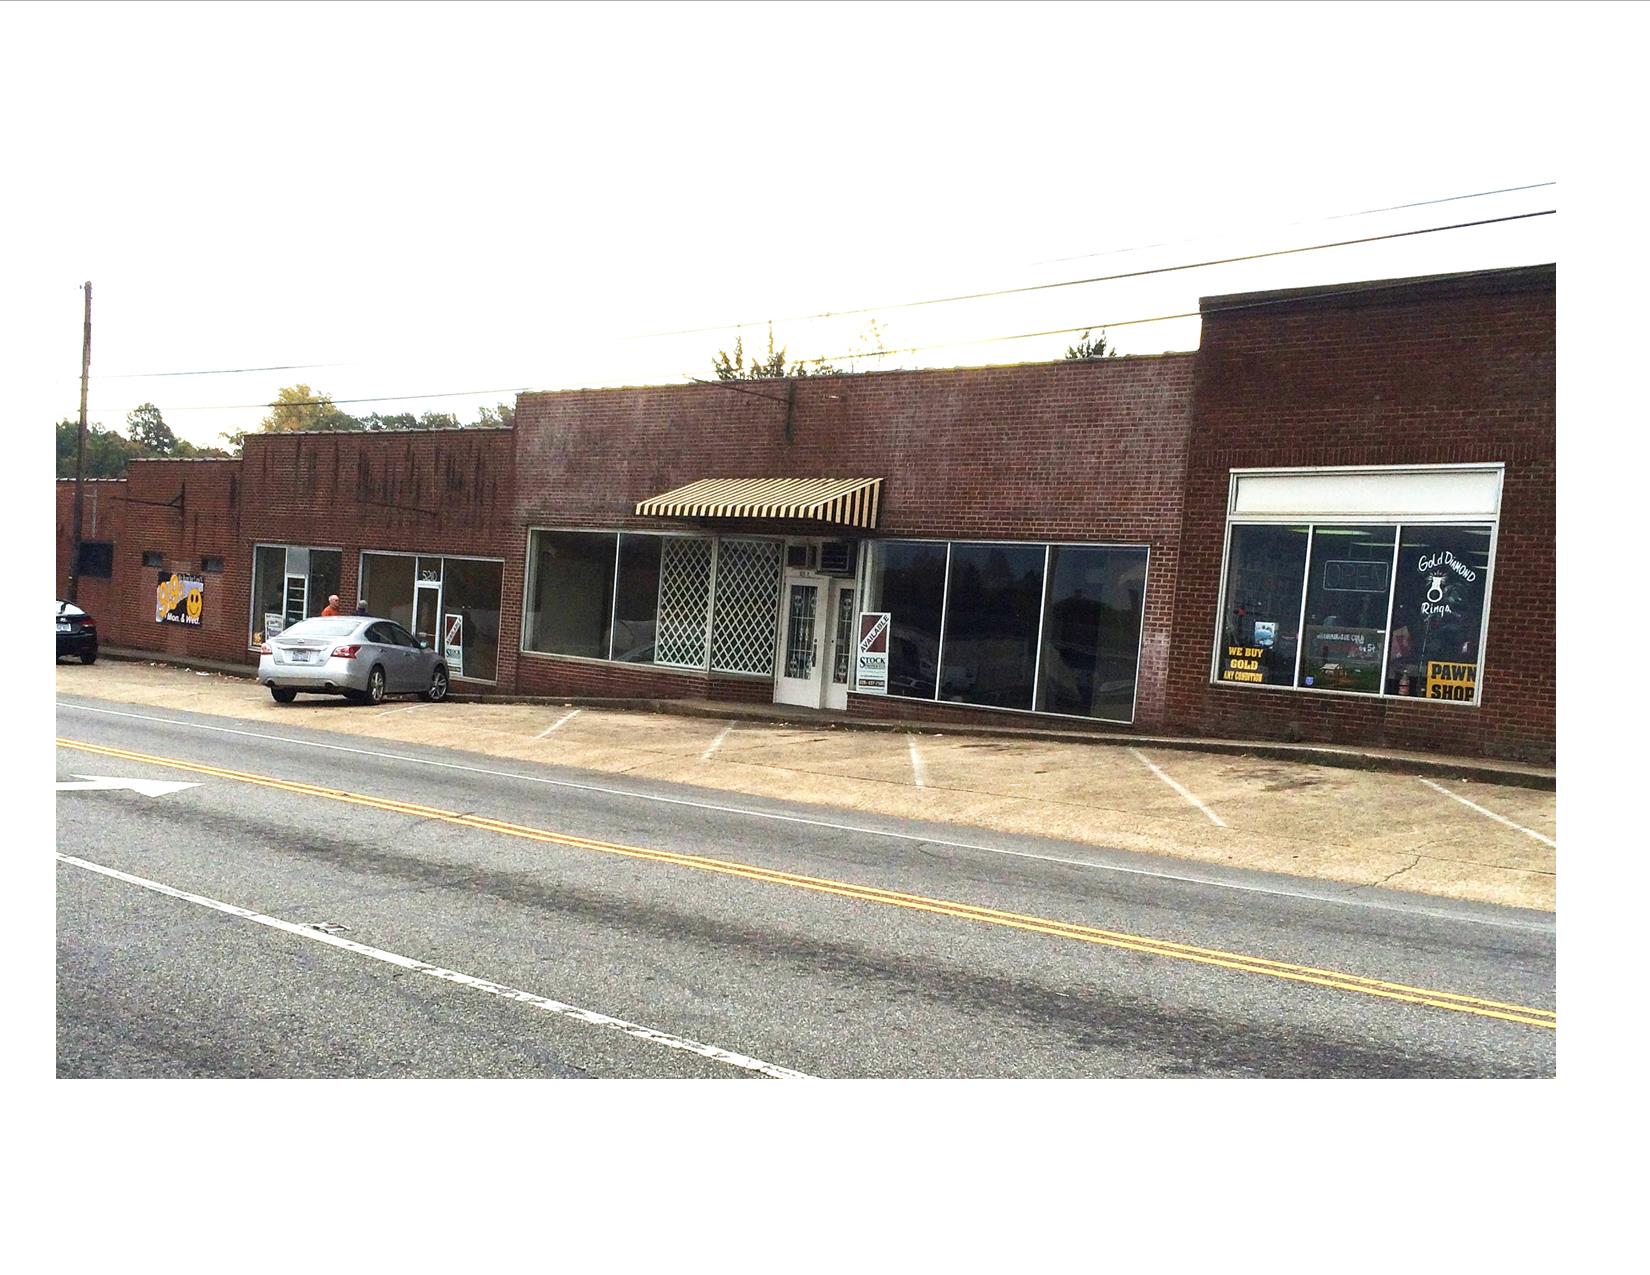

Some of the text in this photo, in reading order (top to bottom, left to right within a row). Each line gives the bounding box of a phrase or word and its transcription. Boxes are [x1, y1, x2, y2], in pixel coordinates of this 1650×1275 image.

[1418, 551, 1444, 572] Gold
[1325, 563, 1387, 590] OPEN
[180, 613, 185, 623] &
[860, 614, 890, 653] AVAILABLE
[1228, 646, 1264, 658] WE BUY
[859, 656, 886, 669] STOCK
[1230, 659, 1259, 670] GOLD
[1223, 670, 1234, 680] ANY
[1431, 663, 1477, 682] PAWN
[1430, 684, 1475, 702] SHOP
